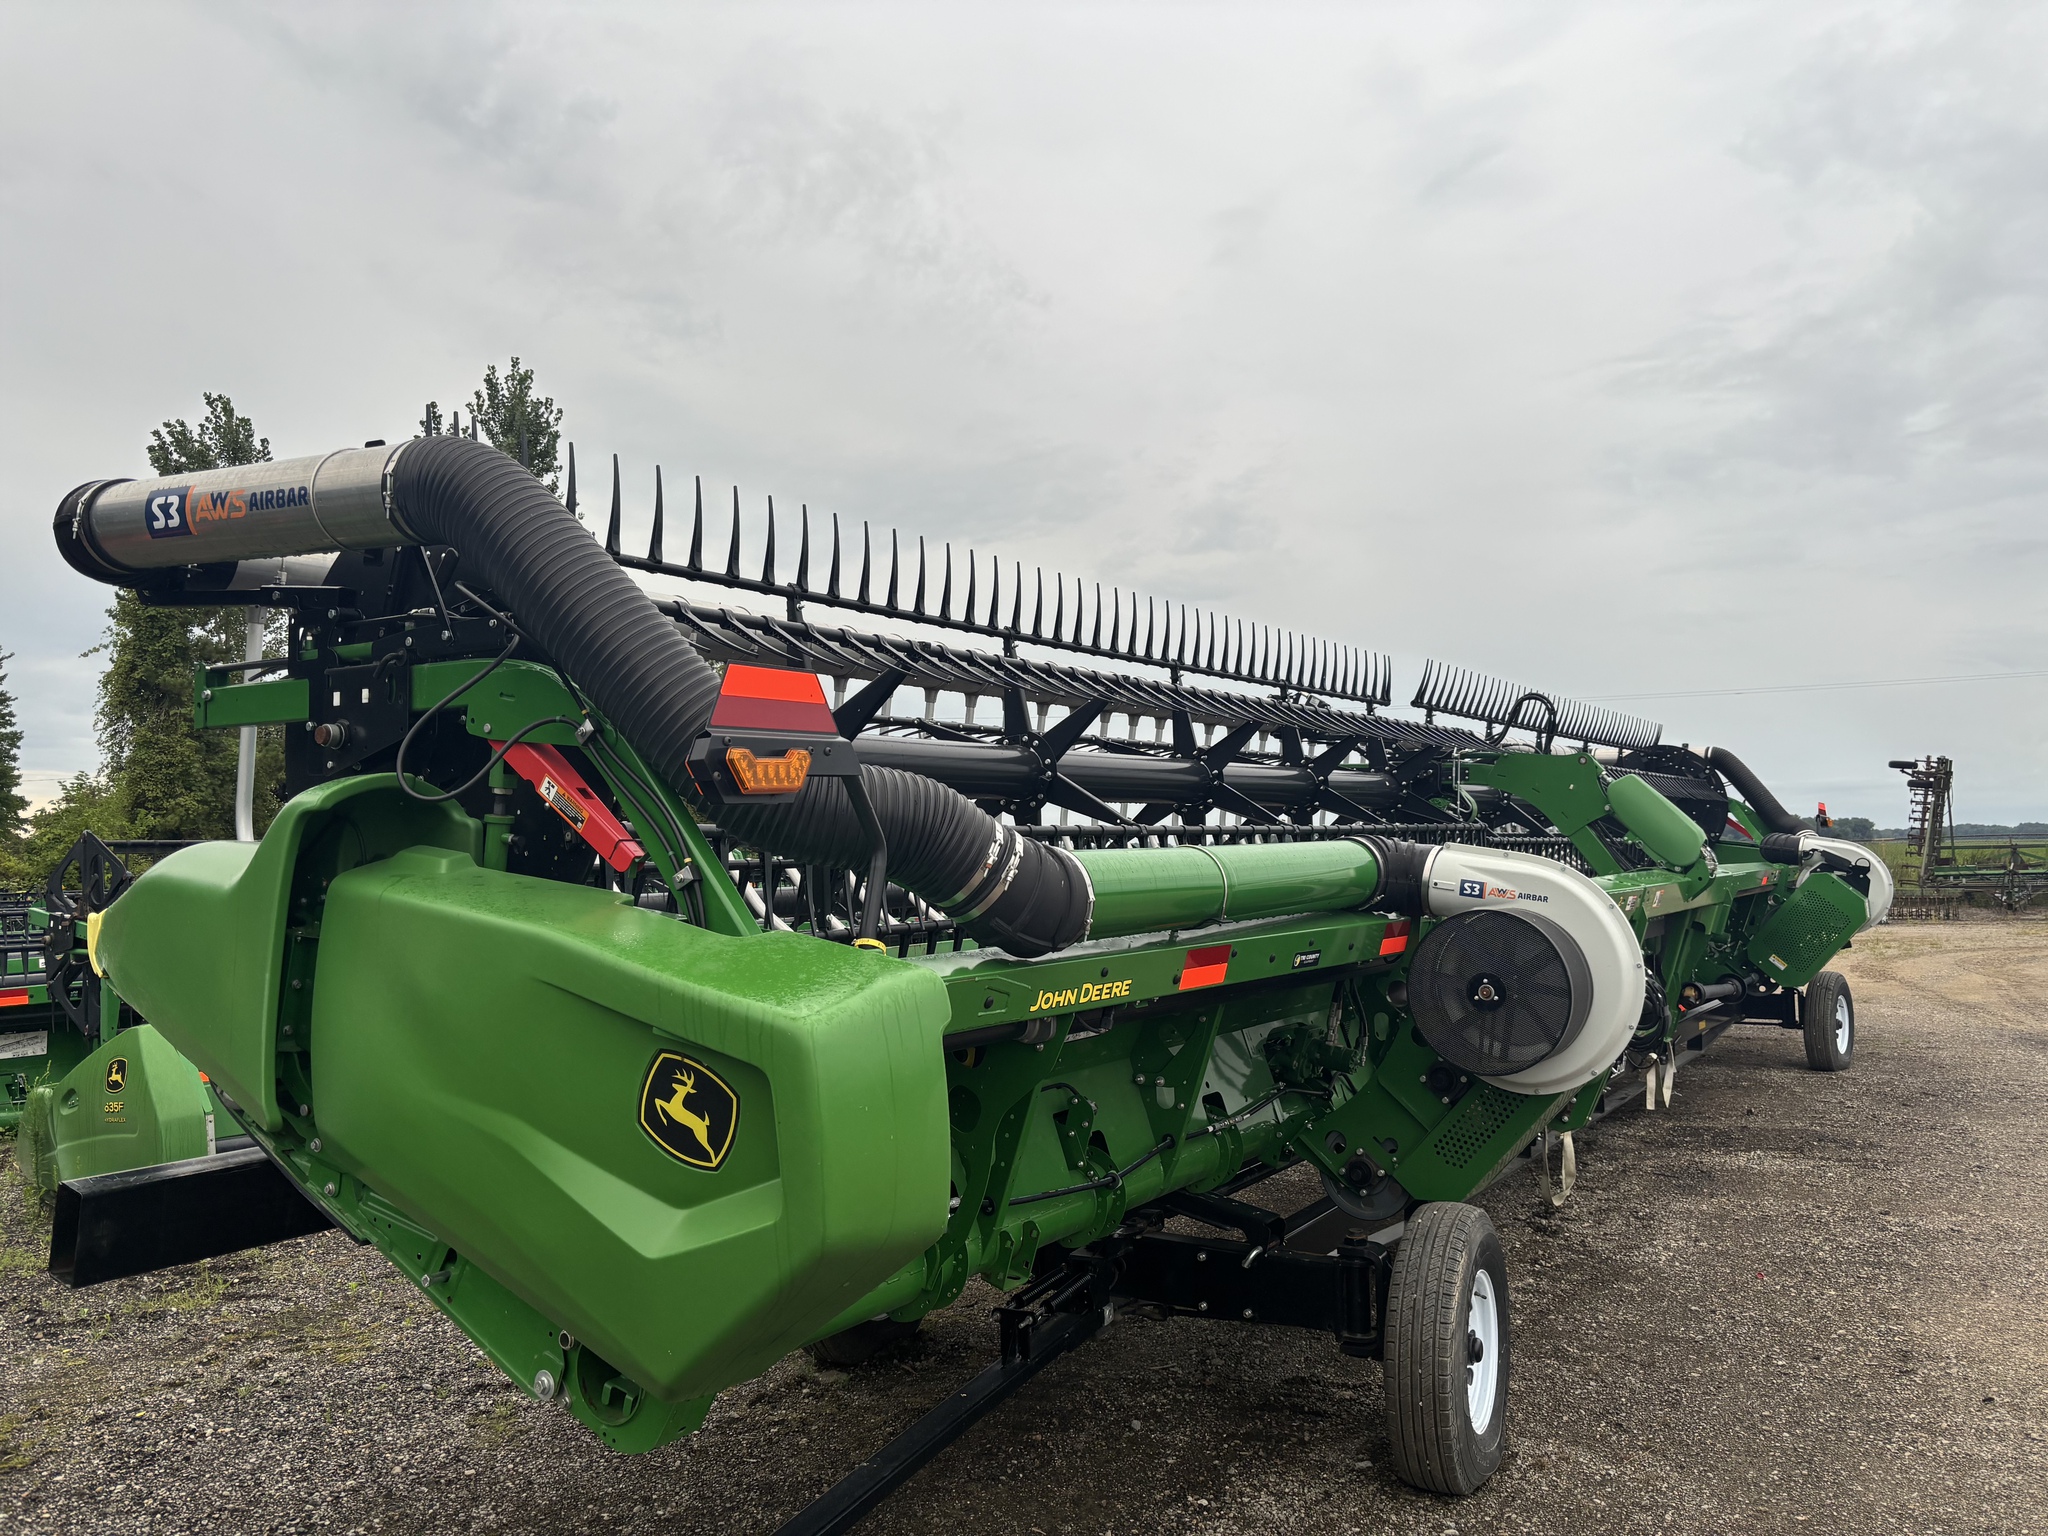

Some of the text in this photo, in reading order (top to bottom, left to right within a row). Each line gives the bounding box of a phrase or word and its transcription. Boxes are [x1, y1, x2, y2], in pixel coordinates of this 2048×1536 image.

[151, 485, 309, 530] S3 AWS AIRBAR
[1463, 882, 1549, 903] S3 AWS AIRBAR
[1029, 979, 1133, 1012] JOHN DEERE
[104, 1101, 124, 1113] 635F
